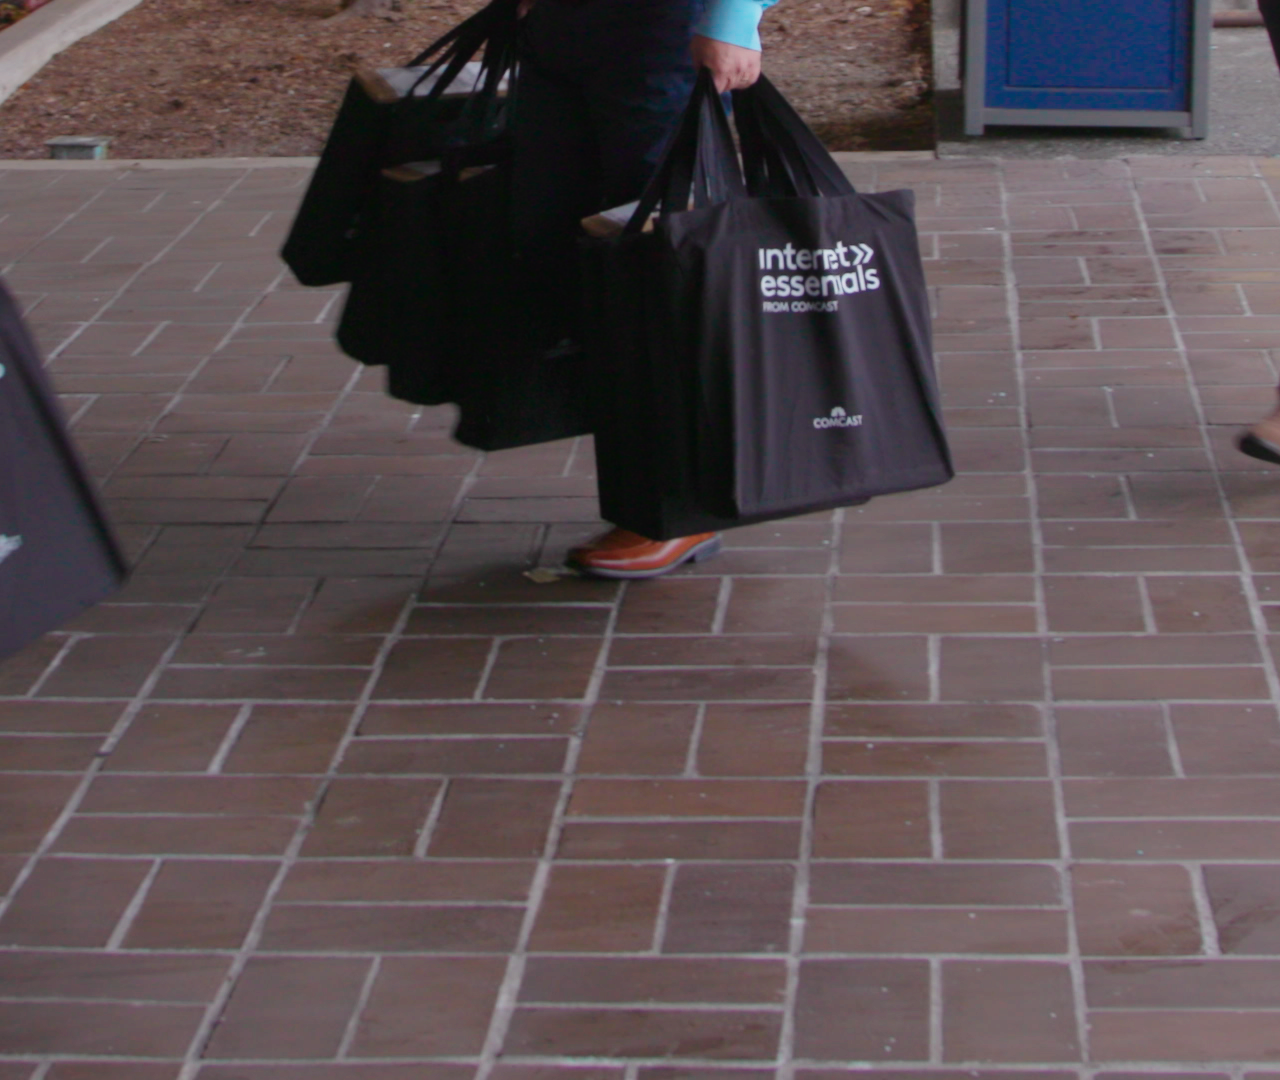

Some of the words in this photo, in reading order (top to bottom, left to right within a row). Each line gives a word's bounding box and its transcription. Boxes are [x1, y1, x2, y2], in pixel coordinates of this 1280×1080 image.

[761, 265, 880, 297] essenials
[762, 301, 789, 312] FROM
[791, 300, 838, 312] COMCAST
[813, 415, 863, 429] COMCAST
